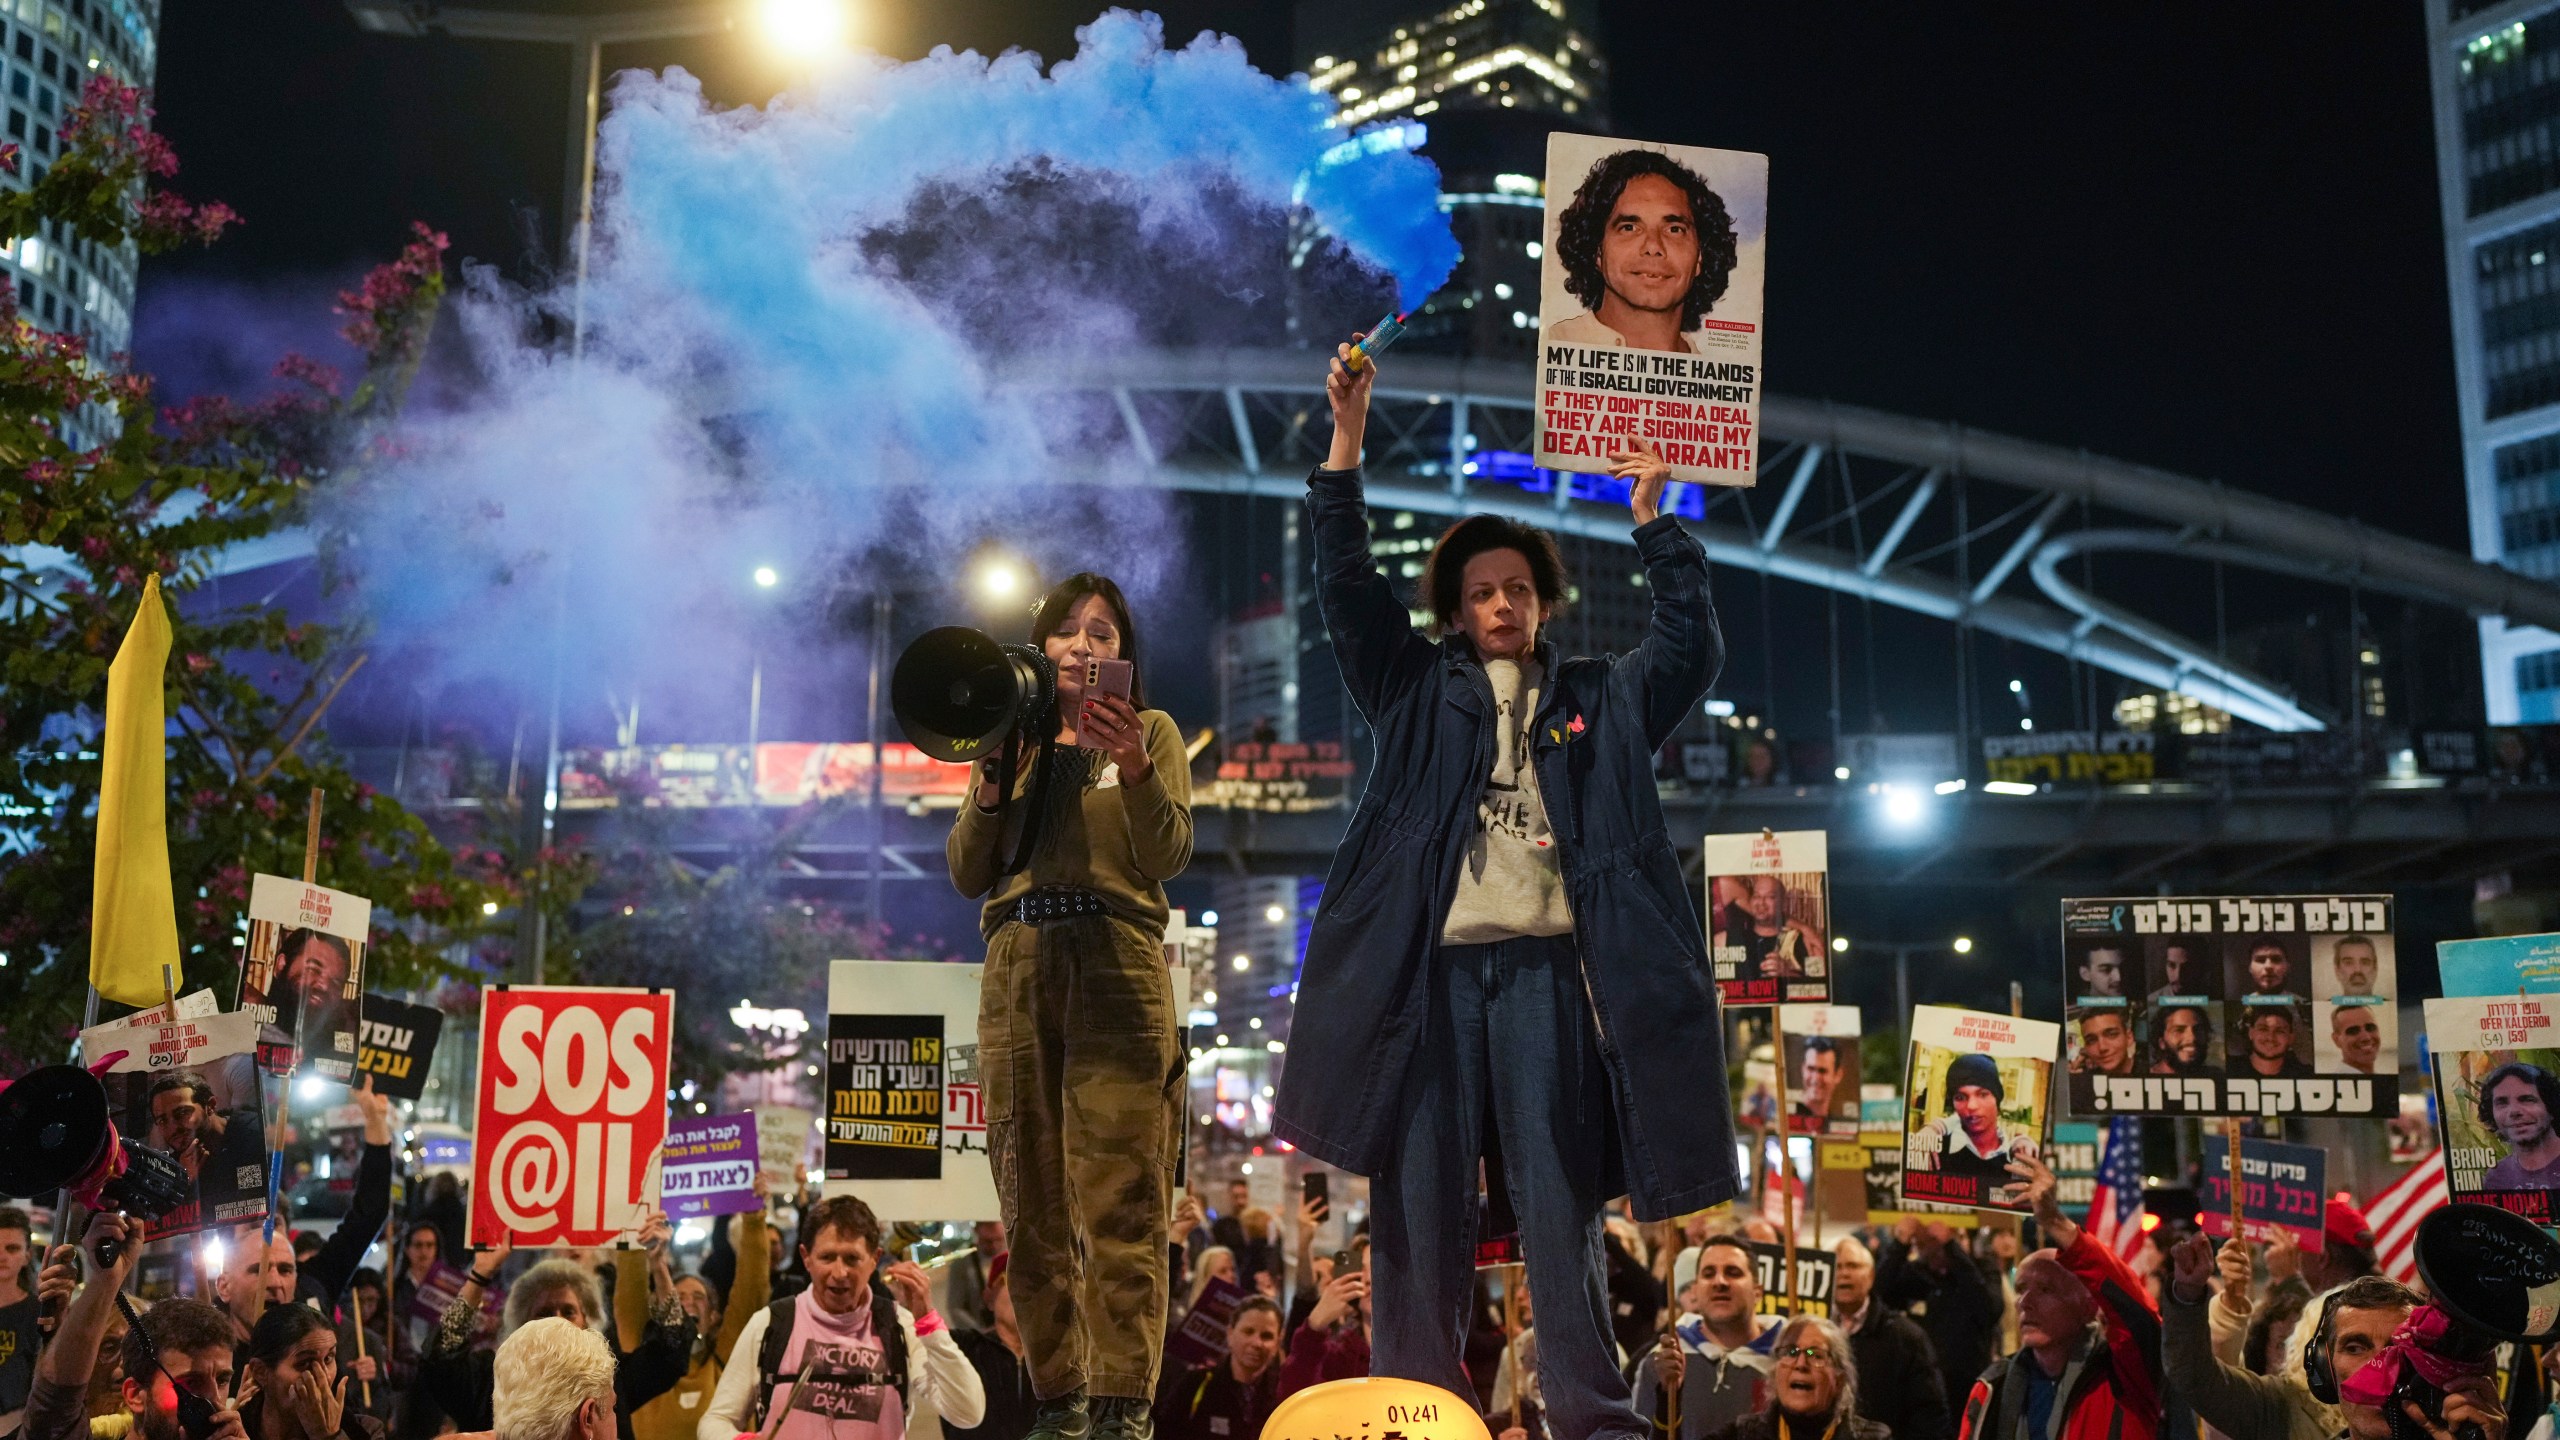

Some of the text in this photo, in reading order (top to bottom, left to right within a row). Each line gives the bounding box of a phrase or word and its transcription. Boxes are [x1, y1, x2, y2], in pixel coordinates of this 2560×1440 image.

[1547, 346, 1754, 384] MY LIFE IS IN THE HANDS
[1546, 368, 1753, 404] OF THE ISRAELI GOVERNMENT
[1545, 390, 1752, 425] IF THEY DON'T SIGN A DEAL
[1544, 409, 1752, 447] THEY ARE SIGNING MY
[1543, 430, 1621, 459] DEATH
[2133, 900, 2212, 934] כולם
[2219, 900, 2295, 933] כולל
[2302, 899, 2386, 932] כולם
[1713, 946, 1746, 963] BRING
[1714, 963, 1736, 980] HIM
[1748, 978, 1778, 996] NOW!
[2487, 1003, 2517, 1017] קלדרון
[160, 1023, 196, 1042] נמרוד כהן
[1953, 1026, 1977, 1038] AVERA
[2480, 1015, 2551, 1030] OFER KALDERON
[149, 1035, 208, 1054] NIMROD COHEN
[2480, 1032, 2503, 1048] (54)
[2508, 1029, 2528, 1044] (53)
[149, 1053, 173, 1067] (20)
[493, 1004, 655, 1117] SOS
[831, 1038, 910, 1064] חודשים
[914, 1038, 937, 1064] 15
[852, 1064, 882, 1090] הם
[887, 1064, 940, 1090] בשבי
[833, 1090, 940, 1116] סכנת מוות
[2092, 1074, 2373, 1117] עסקה היום!
[686, 1131, 707, 1142] את
[708, 1124, 741, 1141] לקבל
[1907, 1132, 1943, 1153] BRING
[690, 1143, 708, 1155] את
[2450, 1147, 2497, 1169] BRING
[1906, 1151, 1930, 1171] HIM
[2271, 1162, 2306, 1182] פדיון
[488, 1120, 650, 1233] @IL
[664, 1164, 749, 1190] לצאת מע
[1906, 1172, 1940, 1193] HOME
[1942, 1175, 1978, 1198] NOW!
[2453, 1170, 2483, 1192] HIM
[2273, 1181, 2317, 1217] בכל
[2502, 1190, 2550, 1215] NOW!
[215, 1203, 267, 1221] FAMILIES FORUM
[814, 1344, 880, 1370] VICTORY
[812, 1393, 856, 1414] DEAL
